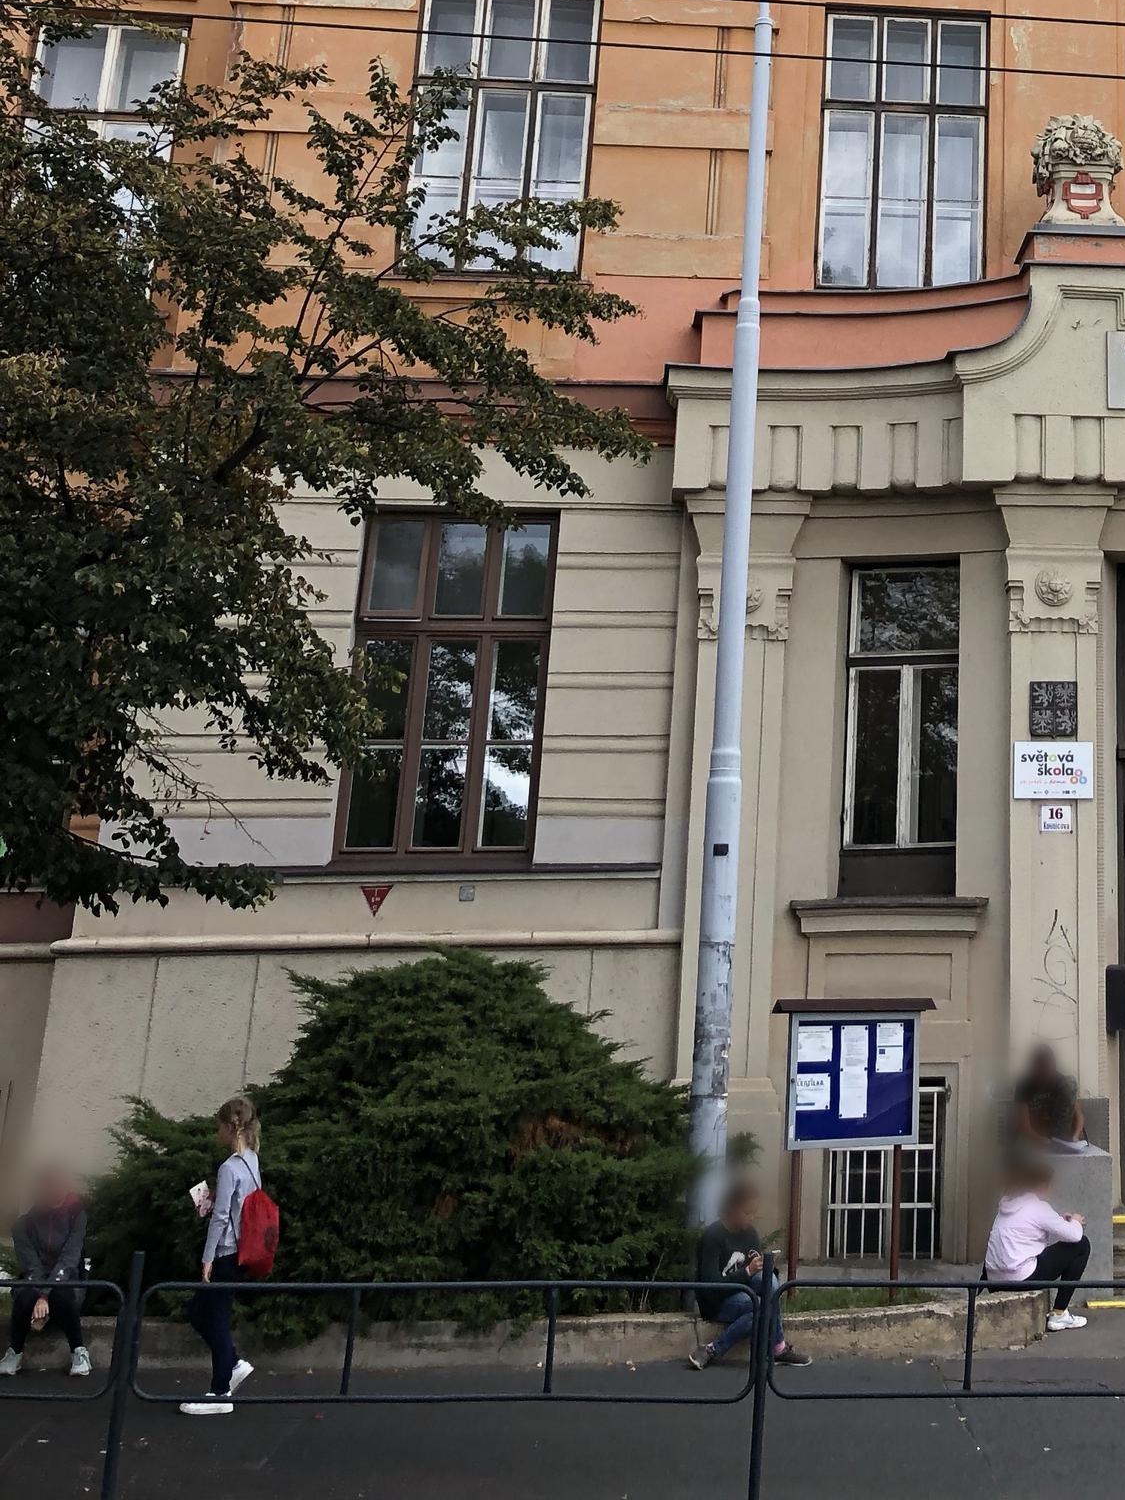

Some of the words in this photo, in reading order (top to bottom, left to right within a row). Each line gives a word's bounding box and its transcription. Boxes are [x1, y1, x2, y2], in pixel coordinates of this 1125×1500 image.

[1020, 750, 1074, 763] světová
[1037, 763, 1074, 776] škola
[1048, 808, 1063, 820] 16
